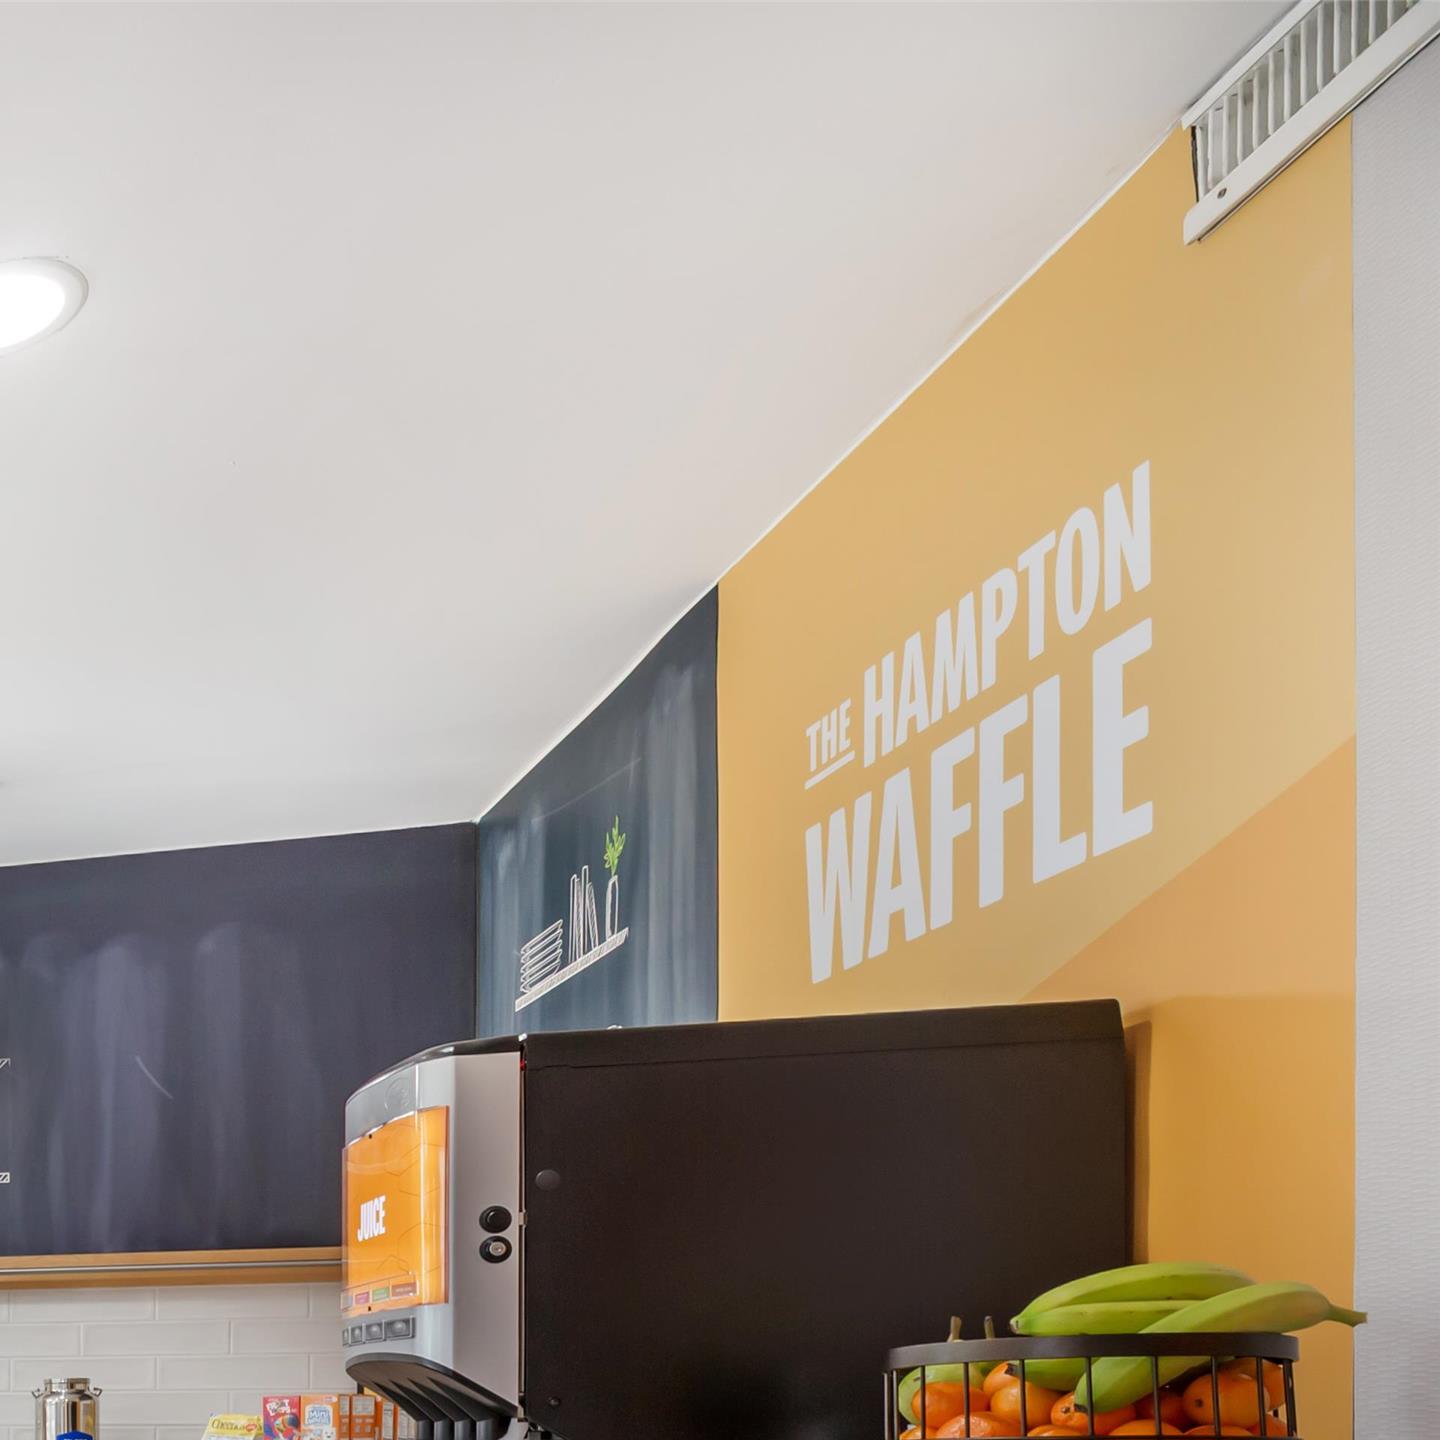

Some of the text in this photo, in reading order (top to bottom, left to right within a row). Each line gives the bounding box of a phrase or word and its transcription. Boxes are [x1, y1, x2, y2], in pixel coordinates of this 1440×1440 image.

[805, 459, 1152, 773] THE HAMPTON
[805, 616, 1153, 985] WAFFLE
[357, 1195, 386, 1242] JUICE
